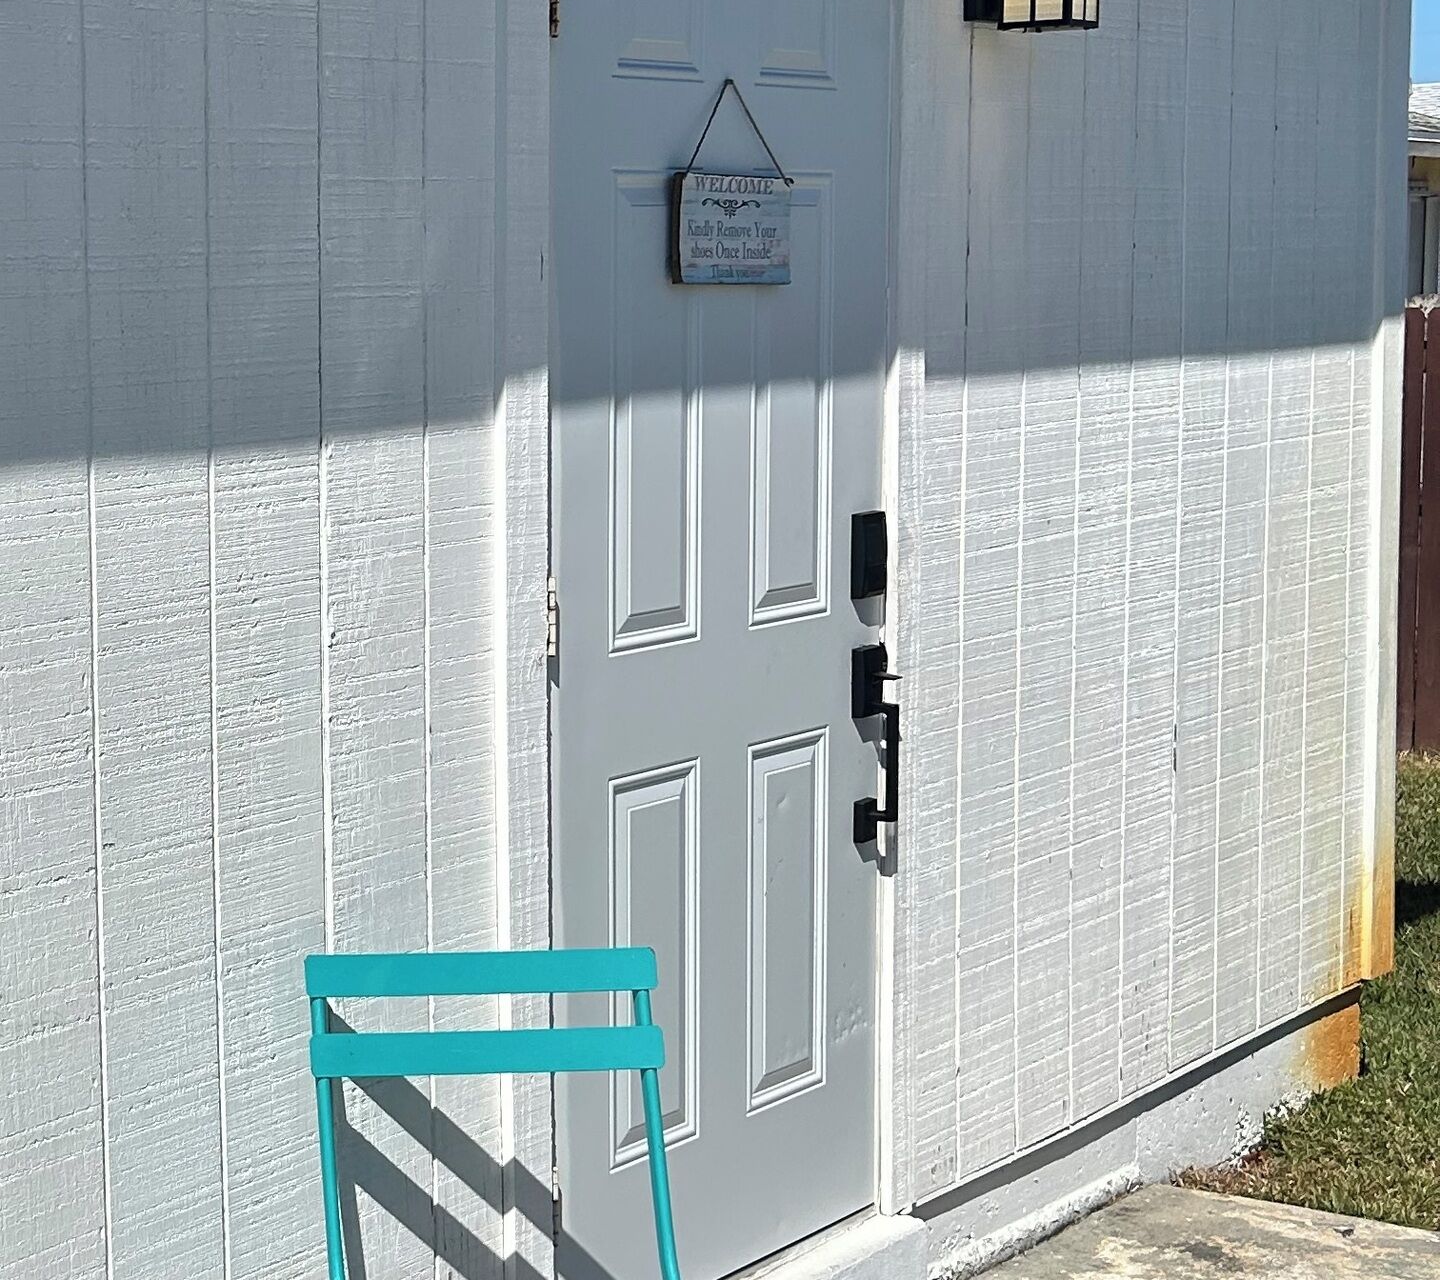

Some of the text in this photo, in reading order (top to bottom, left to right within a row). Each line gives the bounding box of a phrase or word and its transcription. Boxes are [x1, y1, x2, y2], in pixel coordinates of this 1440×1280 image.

[694, 176, 774, 195] WELCOME
[687, 219, 777, 239] Kindly Remove Your
[716, 240, 740, 259] Once
[742, 241, 771, 260] Inside
